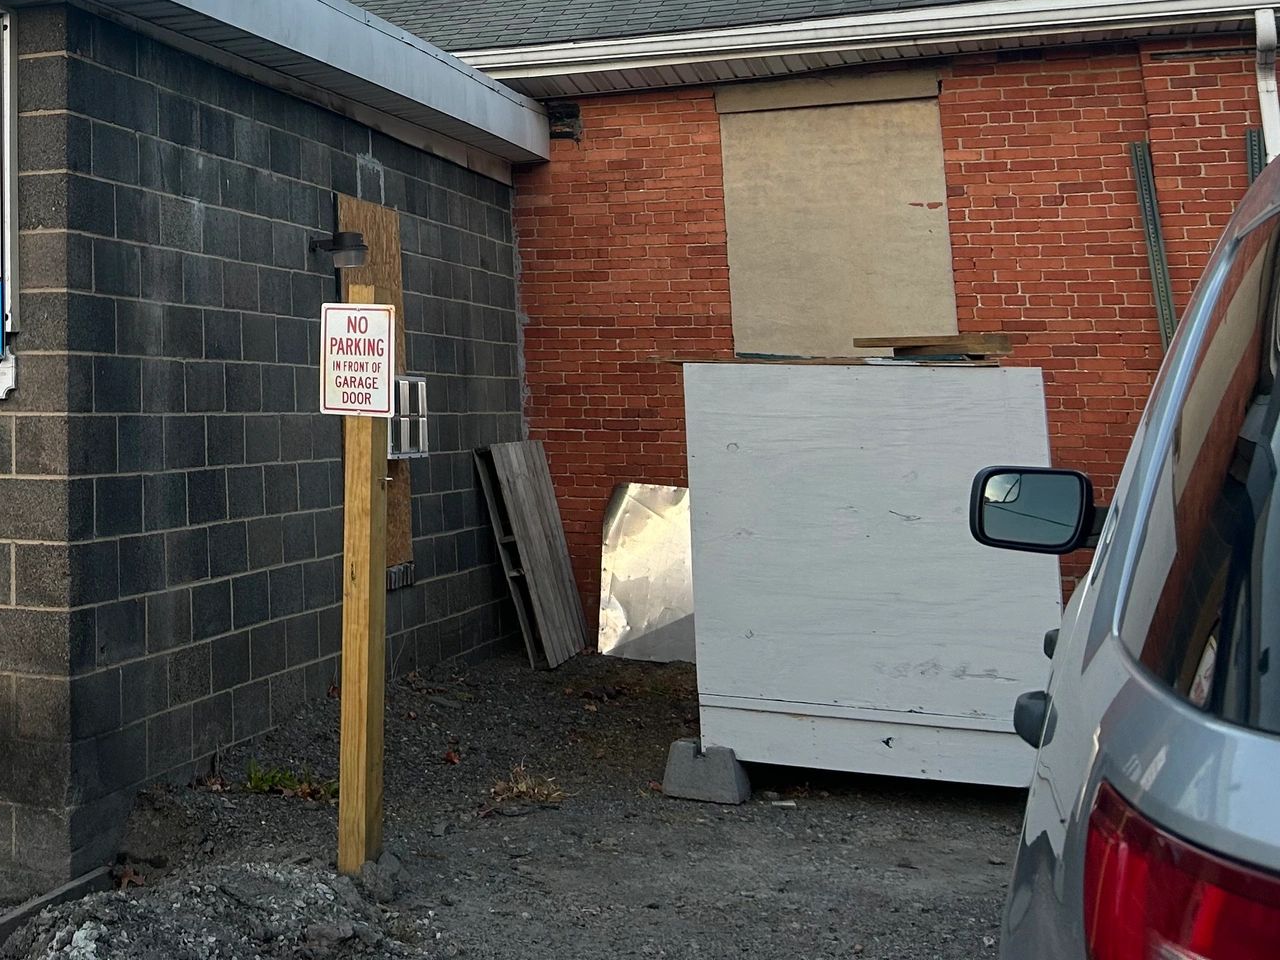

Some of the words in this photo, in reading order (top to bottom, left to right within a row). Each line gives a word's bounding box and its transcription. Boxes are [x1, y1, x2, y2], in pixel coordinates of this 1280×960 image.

[347, 316, 368, 334] NO
[330, 337, 384, 356] PARKING
[332, 361, 341, 371] IN
[343, 361, 369, 373] FRONT
[372, 362, 382, 373] OF
[335, 375, 379, 389] GARAGE
[342, 391, 372, 405] DOOR
